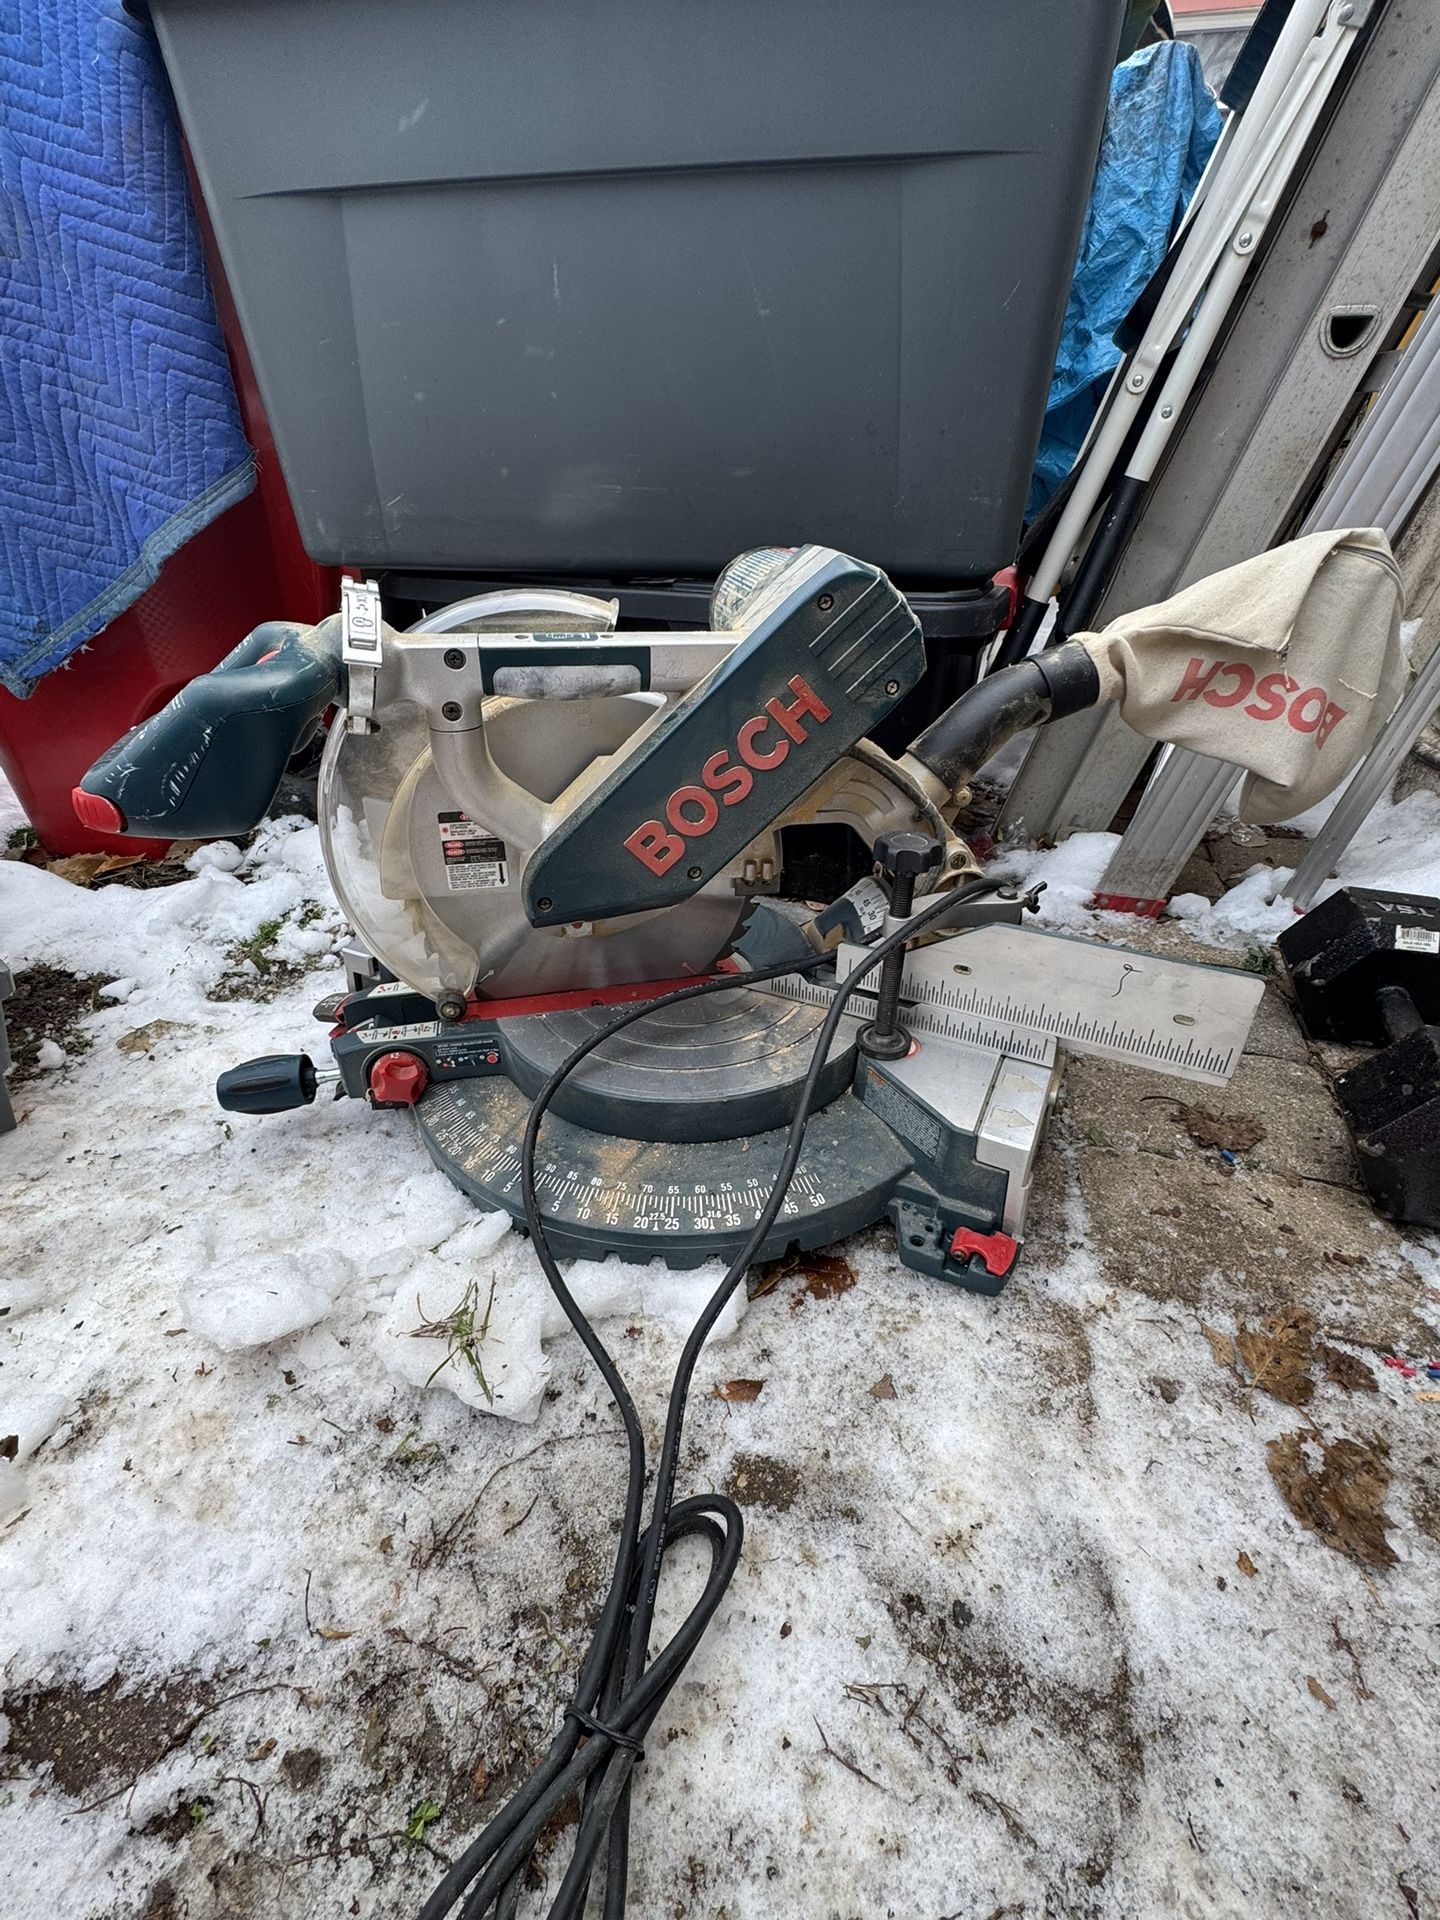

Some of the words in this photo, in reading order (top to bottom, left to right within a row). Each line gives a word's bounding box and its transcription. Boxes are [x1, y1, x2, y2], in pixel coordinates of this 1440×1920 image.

[1170, 657, 1350, 751] BOSCH
[623, 673, 832, 878] BOSCH
[436, 1128, 449, 1142] 25
[447, 1143, 462, 1156] 20
[481, 1169, 496, 1182] 10
[503, 1181, 514, 1193] 5
[551, 1200, 561, 1212] 5
[577, 1208, 590, 1220] 10
[606, 1213, 619, 1226] 15
[633, 1216, 649, 1229] 20
[649, 1212, 666, 1221] 22.5
[664, 1218, 680, 1230] 25
[694, 1217, 709, 1230] 30
[706, 1210, 722, 1219] 31.6
[725, 1214, 741, 1227] 35
[784, 1201, 799, 1215] 45
[809, 1192, 826, 1208] 50
[544, 1163, 557, 1174] 90
[566, 1171, 579, 1180] 85
[590, 1176, 603, 1187] 80
[616, 1182, 628, 1191] 75
[642, 1184, 654, 1194] 70
[668, 1185, 680, 1194] 65
[694, 1184, 706, 1194] 60
[720, 1182, 733, 1192] 55
[746, 1178, 759, 1188] 50
